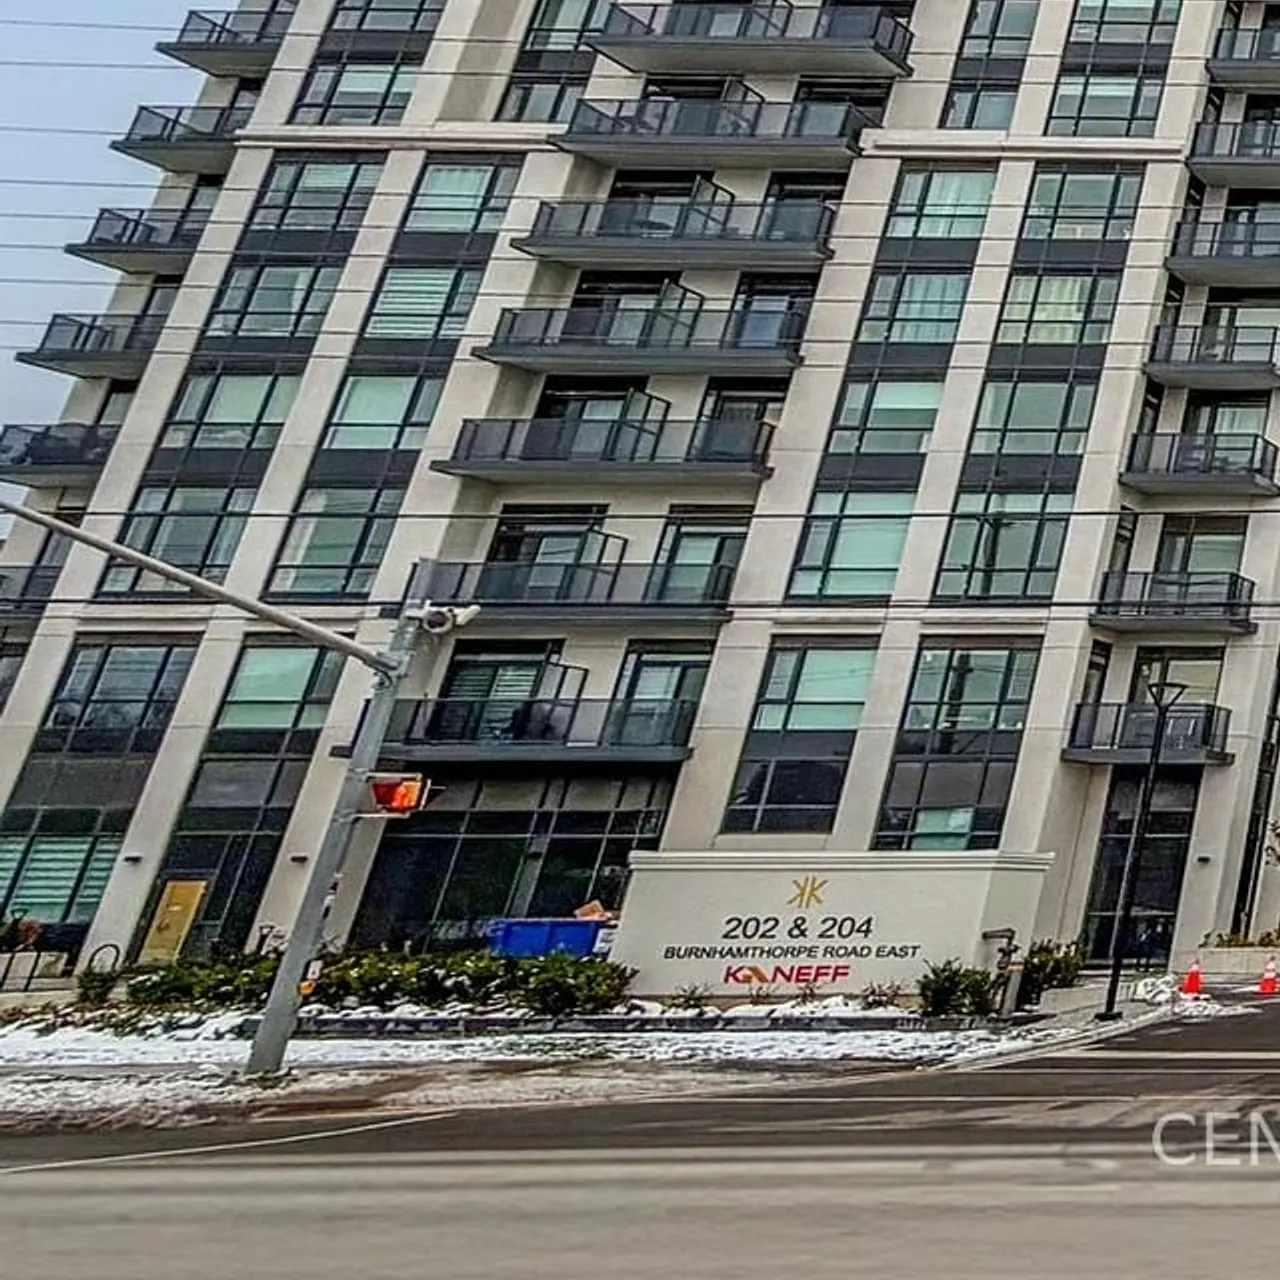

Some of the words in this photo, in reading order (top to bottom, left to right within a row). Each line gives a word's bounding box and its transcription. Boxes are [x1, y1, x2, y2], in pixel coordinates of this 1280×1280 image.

[721, 916, 780, 940] 202
[787, 916, 809, 940] &
[817, 916, 874, 940] 204
[663, 945, 820, 960] BURNHAMTHORPE
[822, 945, 872, 959] ROAD
[874, 945, 921, 959] EAST
[723, 965, 850, 984] KANEFF
